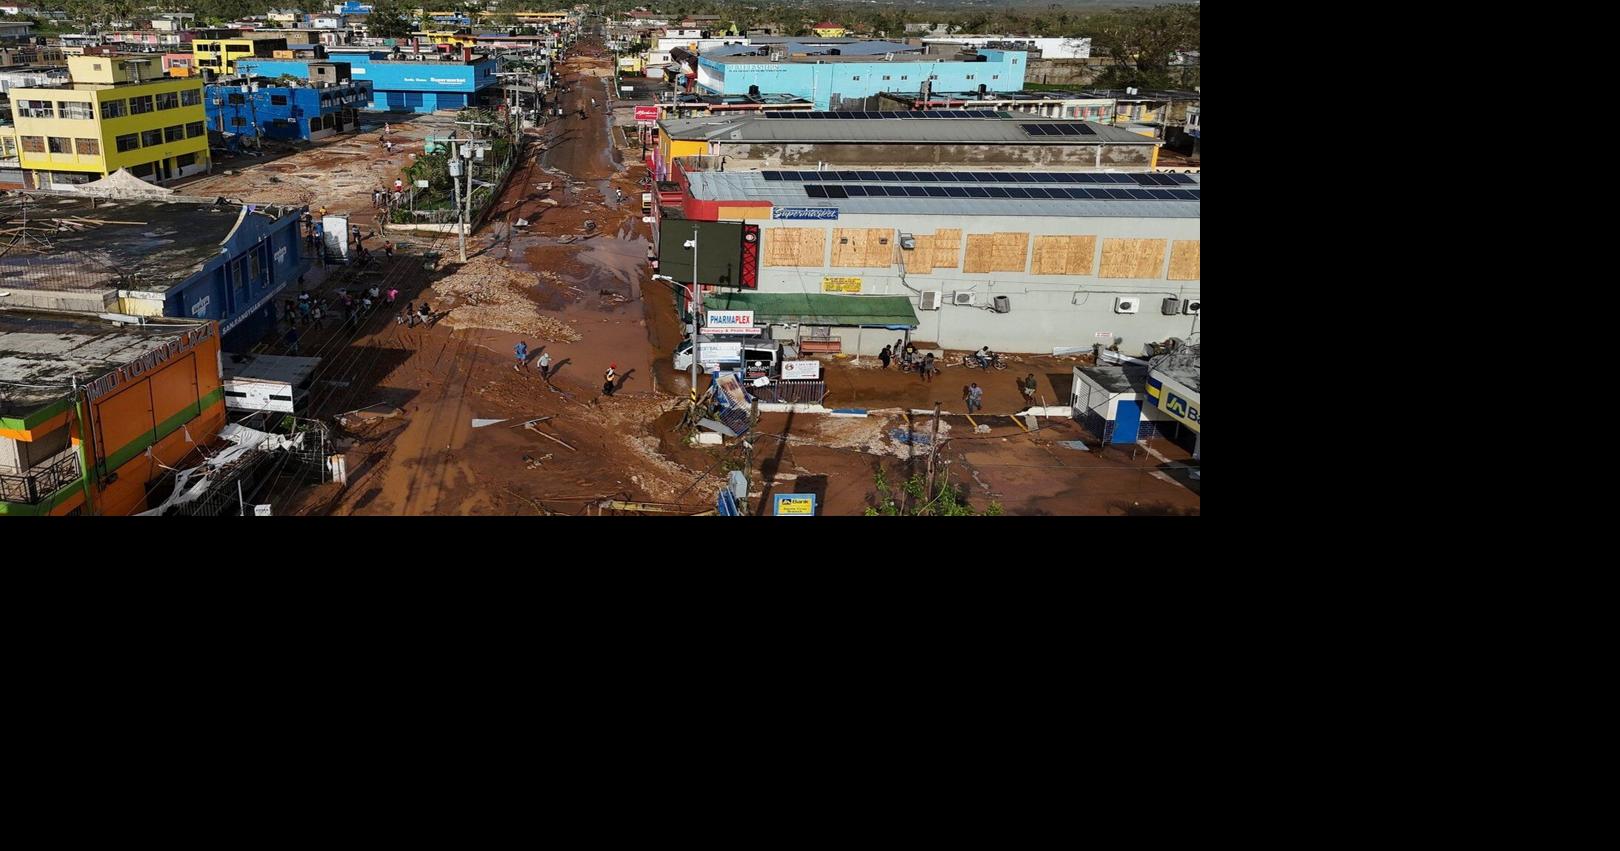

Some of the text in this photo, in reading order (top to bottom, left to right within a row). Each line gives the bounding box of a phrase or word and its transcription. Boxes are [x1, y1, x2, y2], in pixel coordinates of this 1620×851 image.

[774, 208, 838, 219] Supermarket
[710, 316, 750, 324] PHARMAPLEX
[87, 322, 213, 400] MID TOWN PLAZA
